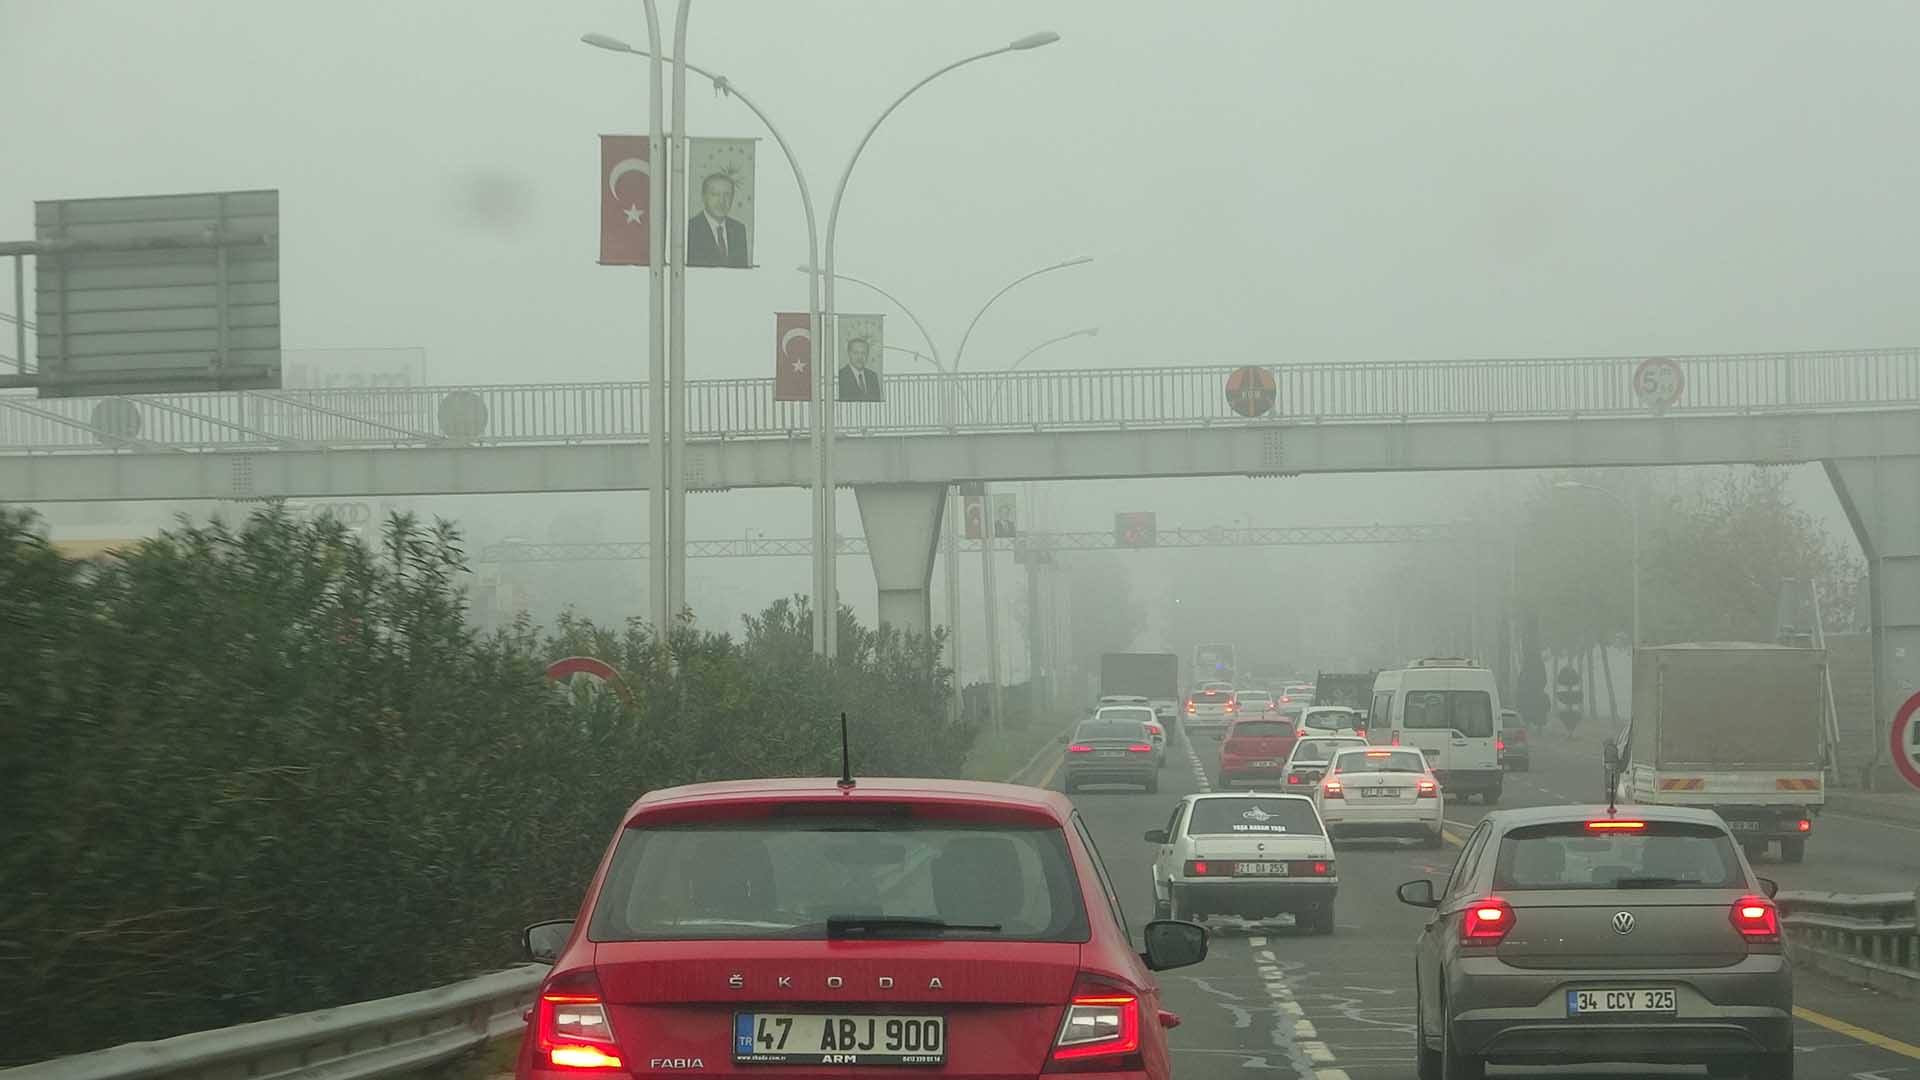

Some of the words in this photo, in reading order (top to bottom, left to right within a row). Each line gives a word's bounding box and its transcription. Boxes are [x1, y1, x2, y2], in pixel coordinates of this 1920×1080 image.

[1239, 863, 1249, 872] 21
[1270, 863, 1285, 873] 255
[729, 974, 943, 989] ŠKODA
[1578, 992, 1597, 1010] 34
[1607, 992, 1635, 1010] CCY
[1645, 991, 1673, 1009] 325
[740, 1035, 752, 1047] TR
[757, 1017, 793, 1051] 47
[820, 1018, 876, 1051] ABJ
[886, 1018, 940, 1052] 900
[650, 1057, 704, 1070] FABIA
[822, 1053, 857, 1064] ARM
